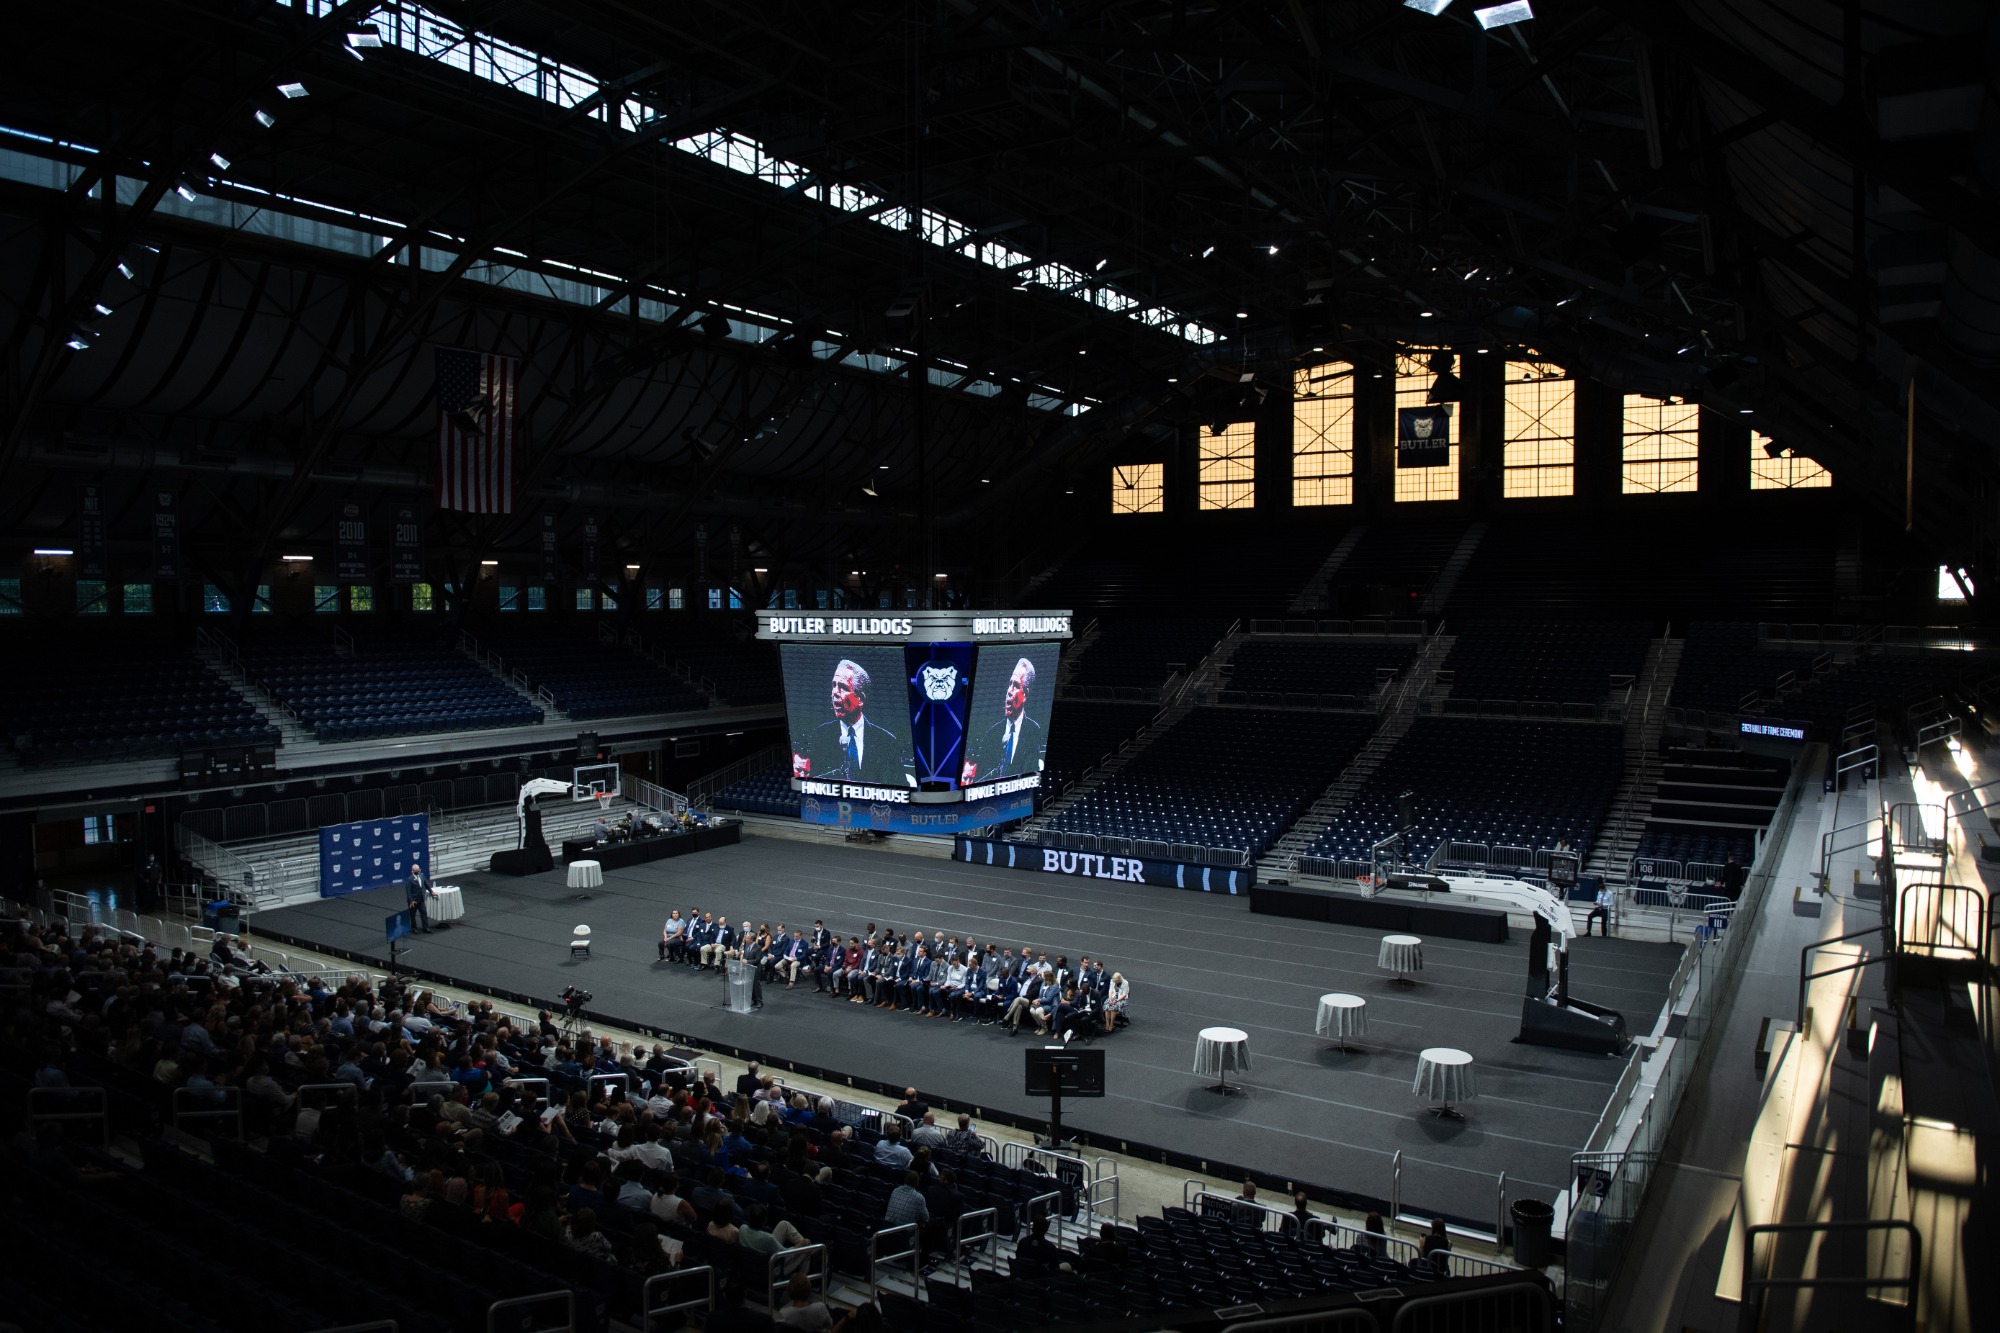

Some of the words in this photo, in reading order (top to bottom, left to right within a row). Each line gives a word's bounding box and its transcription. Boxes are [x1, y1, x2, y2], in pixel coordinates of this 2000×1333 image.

[1400, 438, 1447, 450] BUTLER
[85, 497, 99, 510] NIT
[155, 514, 175, 527] 1924
[339, 521, 364, 540] 2010
[396, 524, 417, 542] 2011
[770, 617, 826, 634] BUTLER
[832, 618, 912, 635] BULLDOGS
[973, 618, 1015, 634] BUTLER
[1018, 617, 1068, 633] BULLDOGS
[1752, 724, 1761, 734] HALL
[1762, 725, 1768, 734] OF
[1768, 726, 1779, 736] FAME
[1780, 727, 1804, 739] CEREMONY
[801, 781, 840, 796] HINKLE
[842, 784, 909, 804] FIELDHOUSE
[965, 784, 995, 802] HINKLE
[995, 776, 1040, 796] FIELDHOUSE
[837, 801, 852, 824] B
[911, 813, 959, 825] BUTLER
[1043, 849, 1146, 883] BUTLER
[1640, 864, 1653, 874] 108
[1537, 904, 1559, 923] SPALDING
[1058, 1160, 1082, 1173] SECTION
[1062, 1170, 1078, 1187] 117
[1203, 1198, 1231, 1211] SECTION
